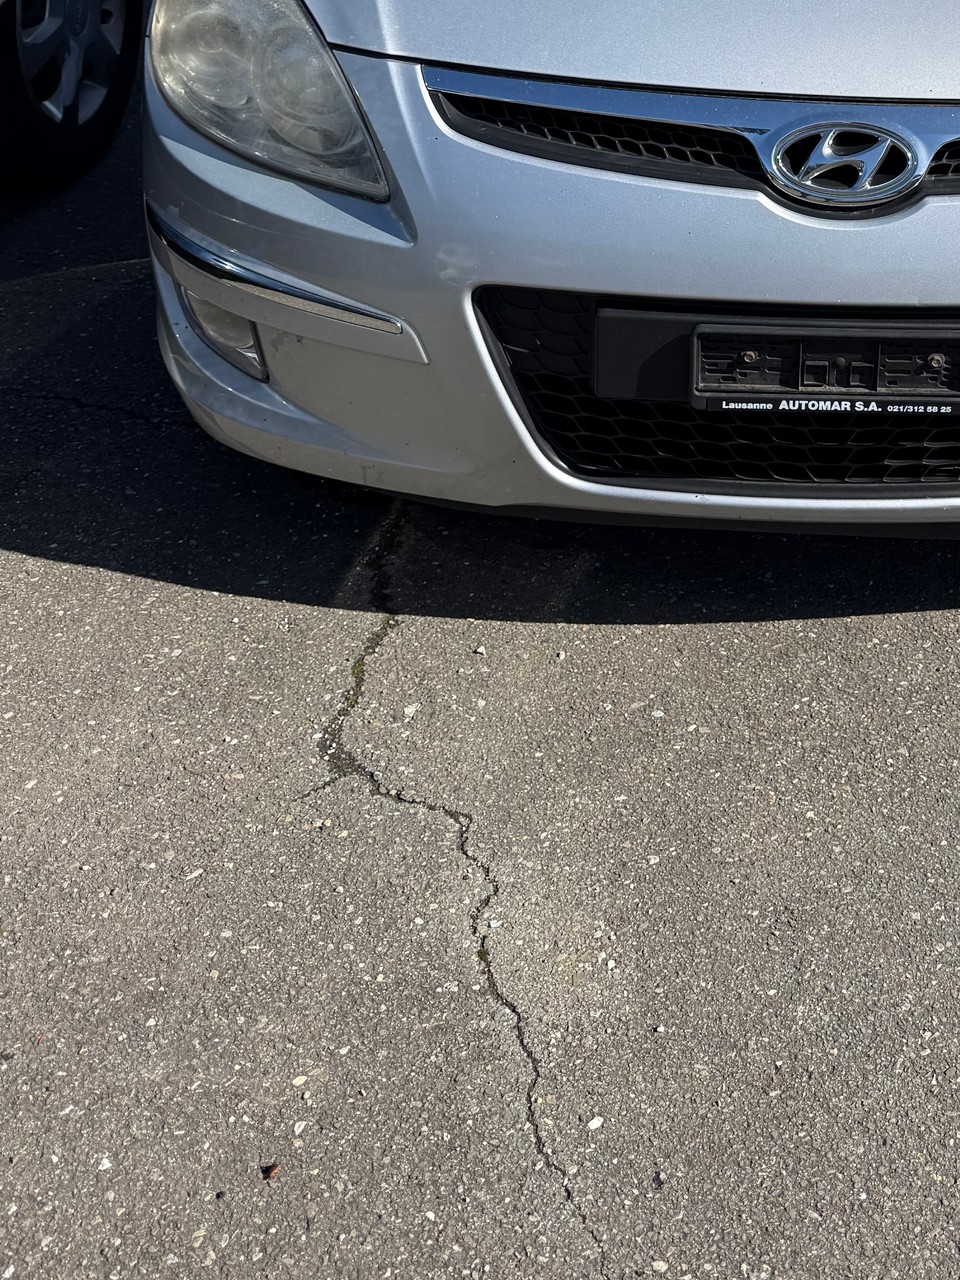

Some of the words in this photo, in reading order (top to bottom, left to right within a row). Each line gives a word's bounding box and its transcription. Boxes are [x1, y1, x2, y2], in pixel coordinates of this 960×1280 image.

[722, 401, 773, 410] Lausanne
[778, 399, 851, 412] AUTOMAR
[855, 401, 883, 412] S.A.
[887, 404, 925, 413] 021/312
